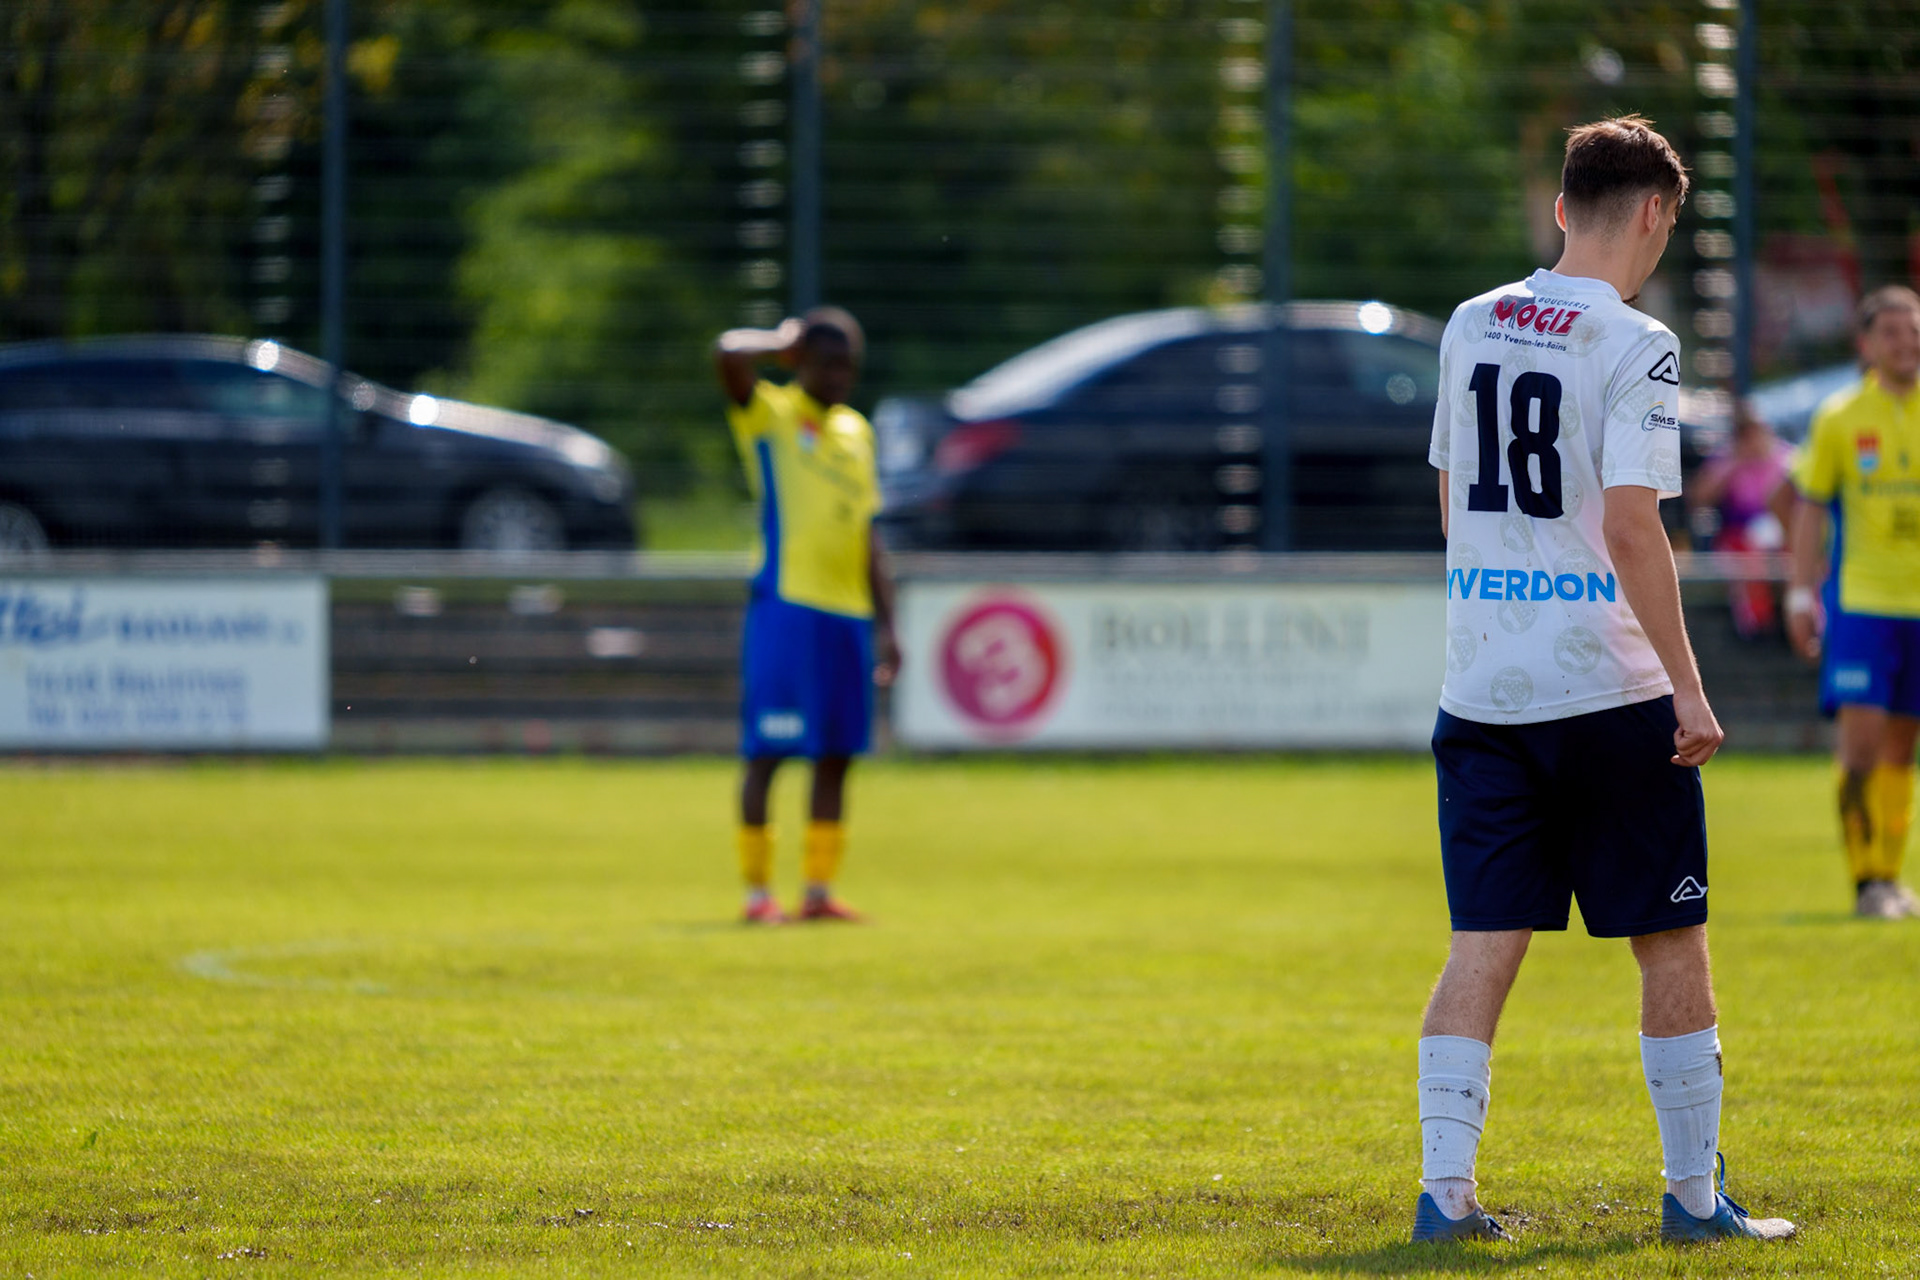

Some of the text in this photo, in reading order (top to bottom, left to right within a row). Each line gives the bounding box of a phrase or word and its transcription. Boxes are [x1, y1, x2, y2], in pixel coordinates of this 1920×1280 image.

[1538, 297, 1590, 310] BOUCHERIE
[1484, 331, 1501, 340] 1400
[1468, 363, 1564, 519] 18
[1447, 568, 1616, 602] YVERDON
